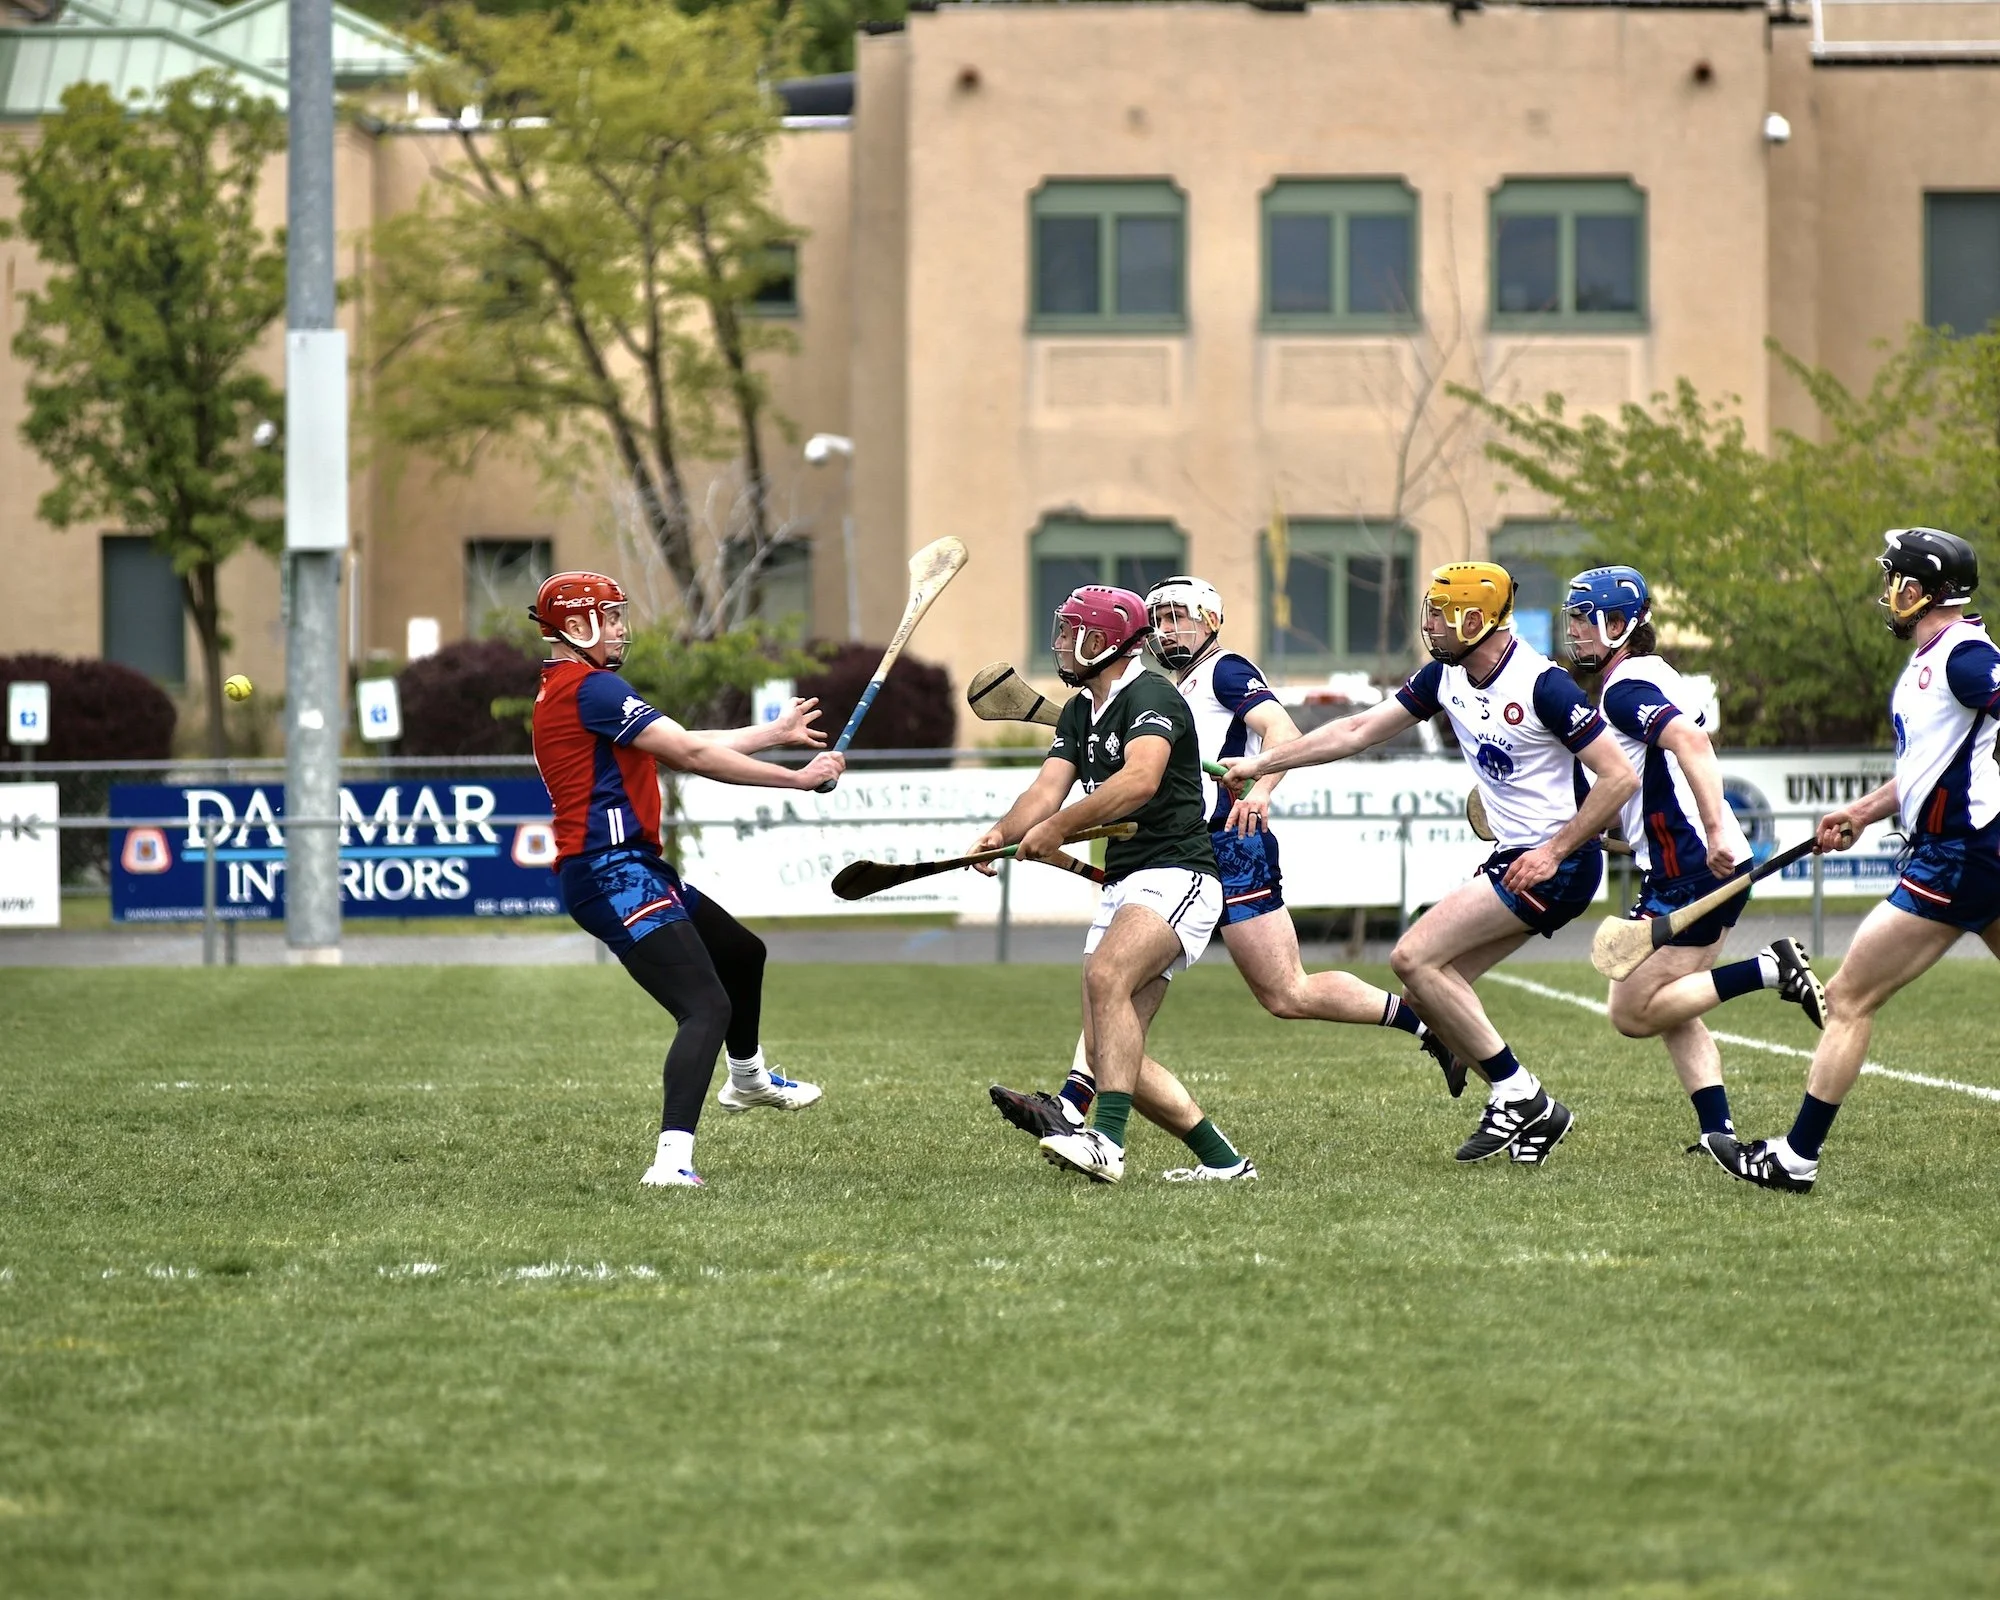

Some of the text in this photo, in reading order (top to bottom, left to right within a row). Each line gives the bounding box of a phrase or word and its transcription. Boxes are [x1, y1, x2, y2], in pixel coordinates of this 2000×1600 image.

[1786, 773, 1897, 806] UNITE
[182, 784, 502, 849] DAMAR
[226, 858, 471, 903] INRIORS
